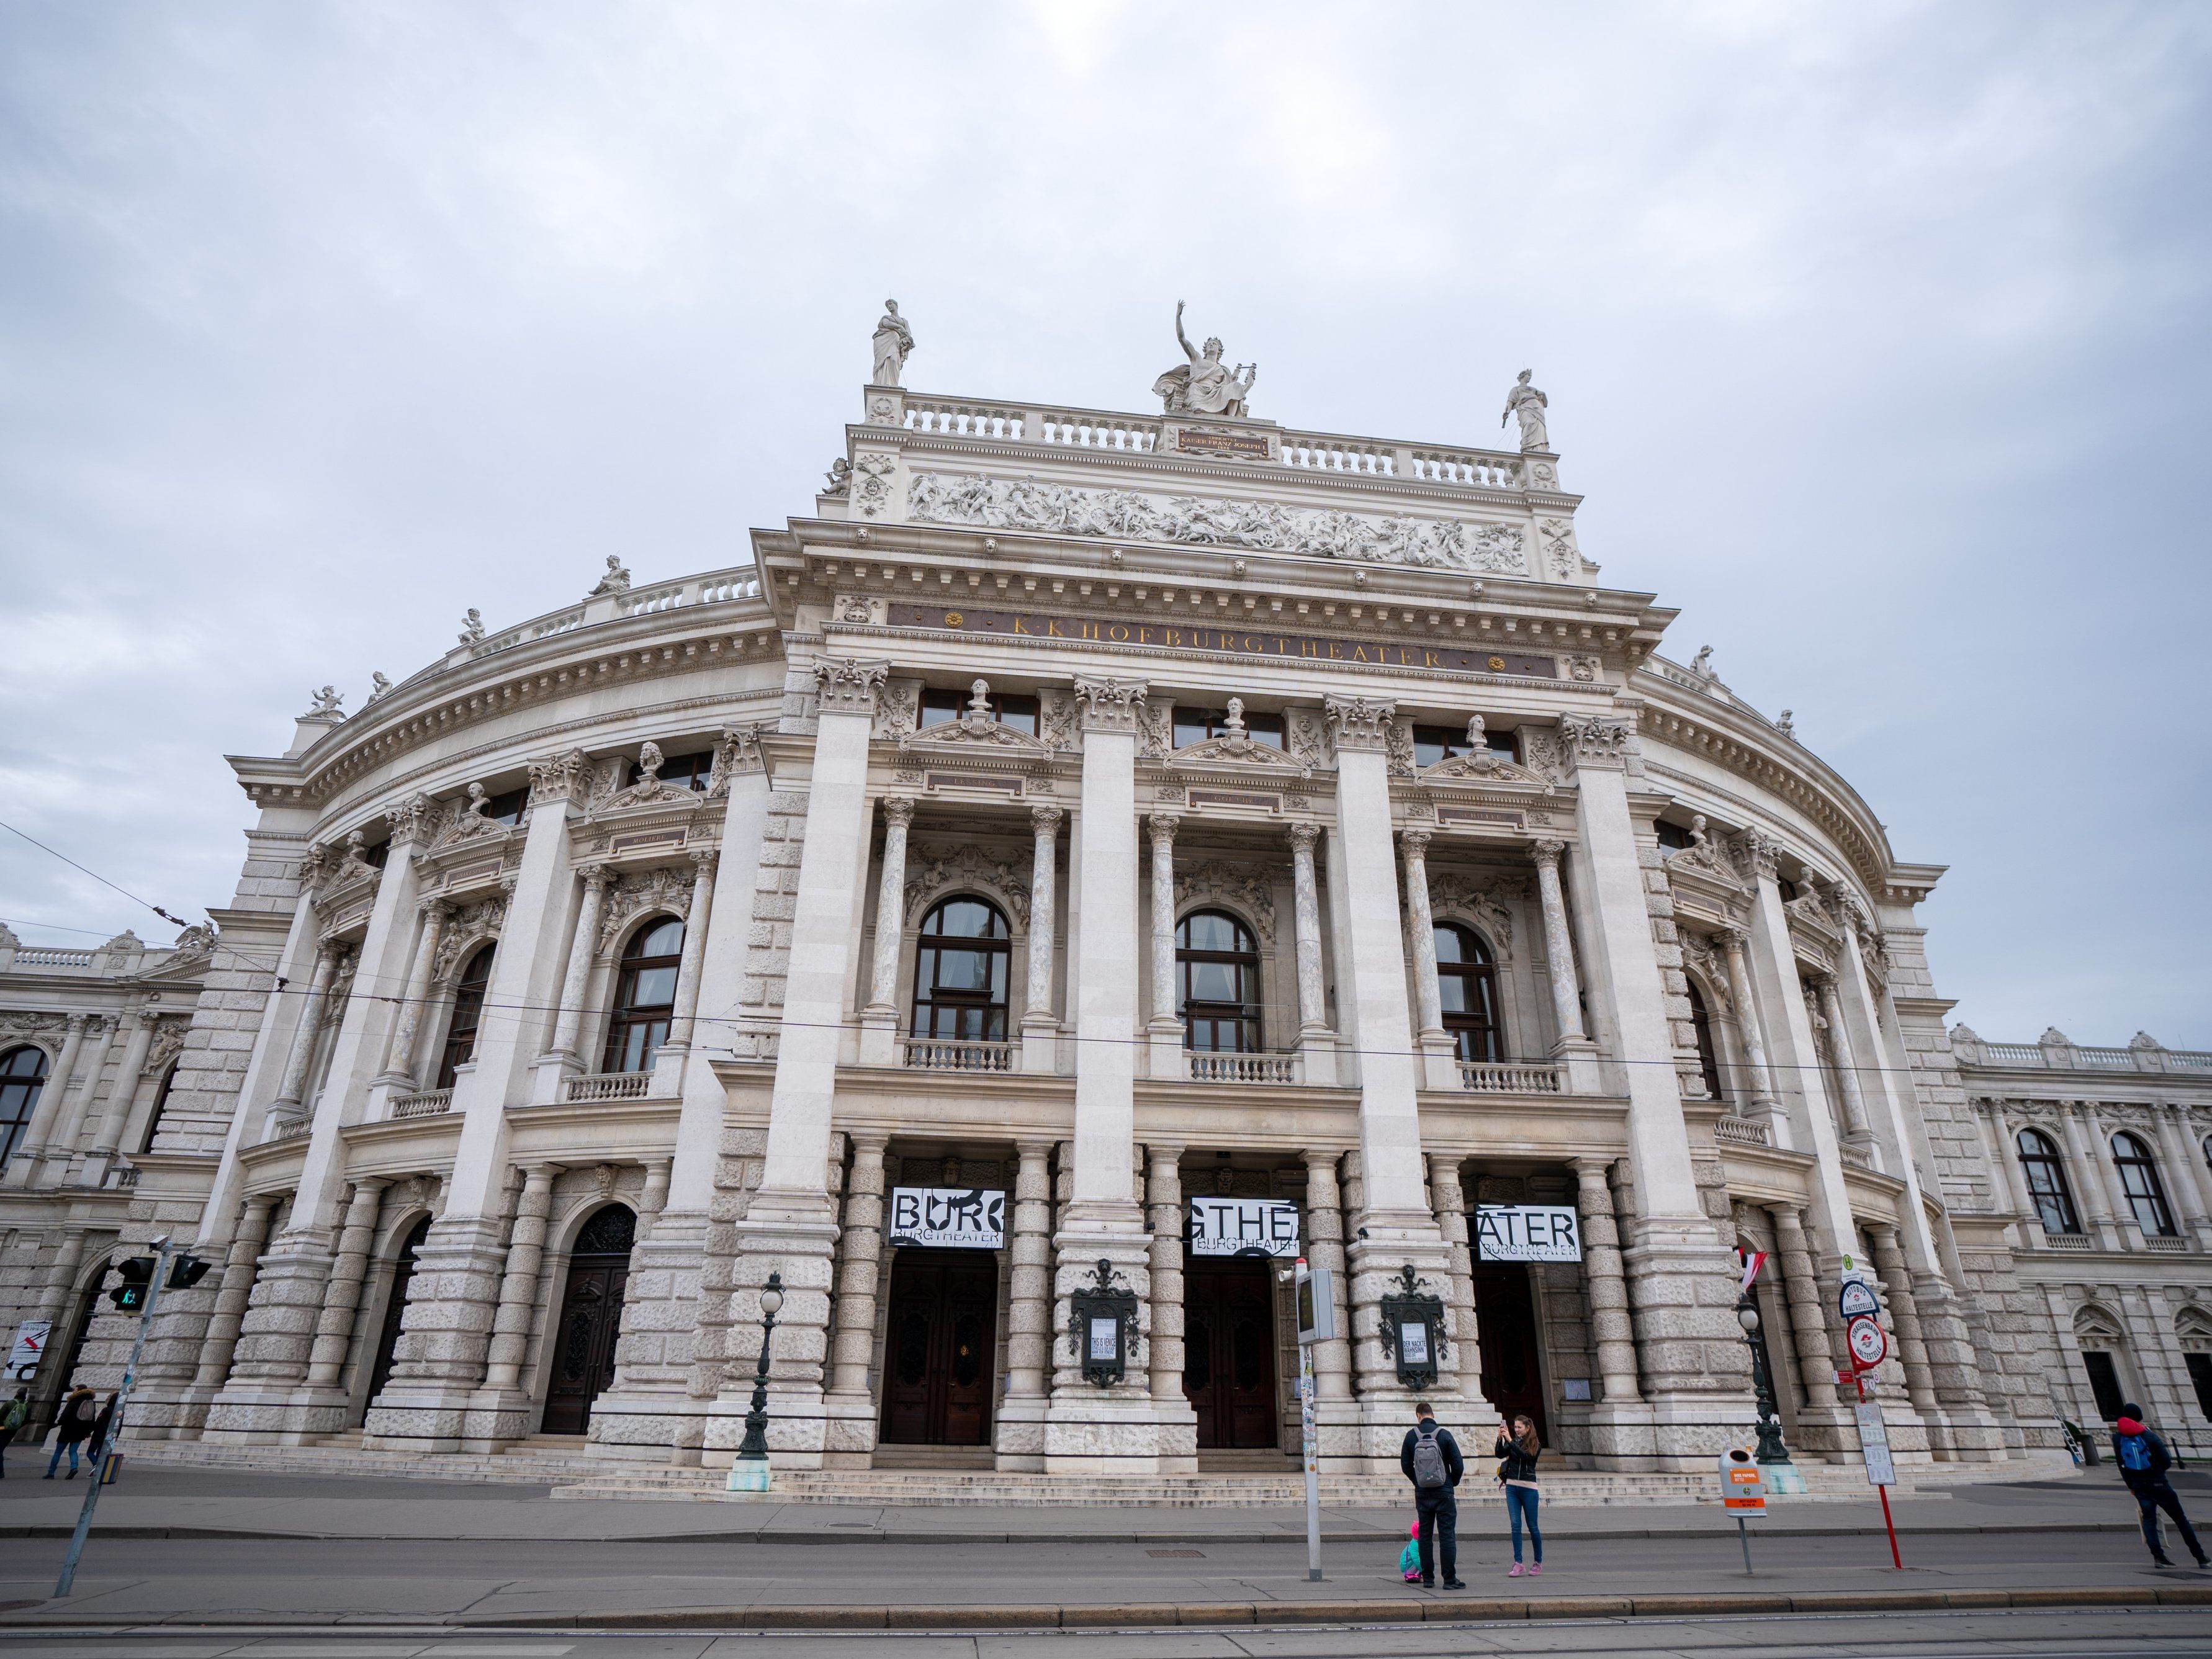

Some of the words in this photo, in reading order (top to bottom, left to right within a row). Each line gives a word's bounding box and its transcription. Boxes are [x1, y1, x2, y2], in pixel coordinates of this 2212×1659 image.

[1478, 1212, 1575, 1246] ATER
[1846, 1285, 1866, 1299] AUTOBUS
[1845, 1302, 1873, 1312] HALTESTELLE
[1851, 1321, 1879, 1339] STRASSENBAHN
[1104, 1338, 1115, 1347] VENICE
[1856, 1344, 1882, 1360] HALTESTELLE
[1863, 1380, 1868, 1388] 71
